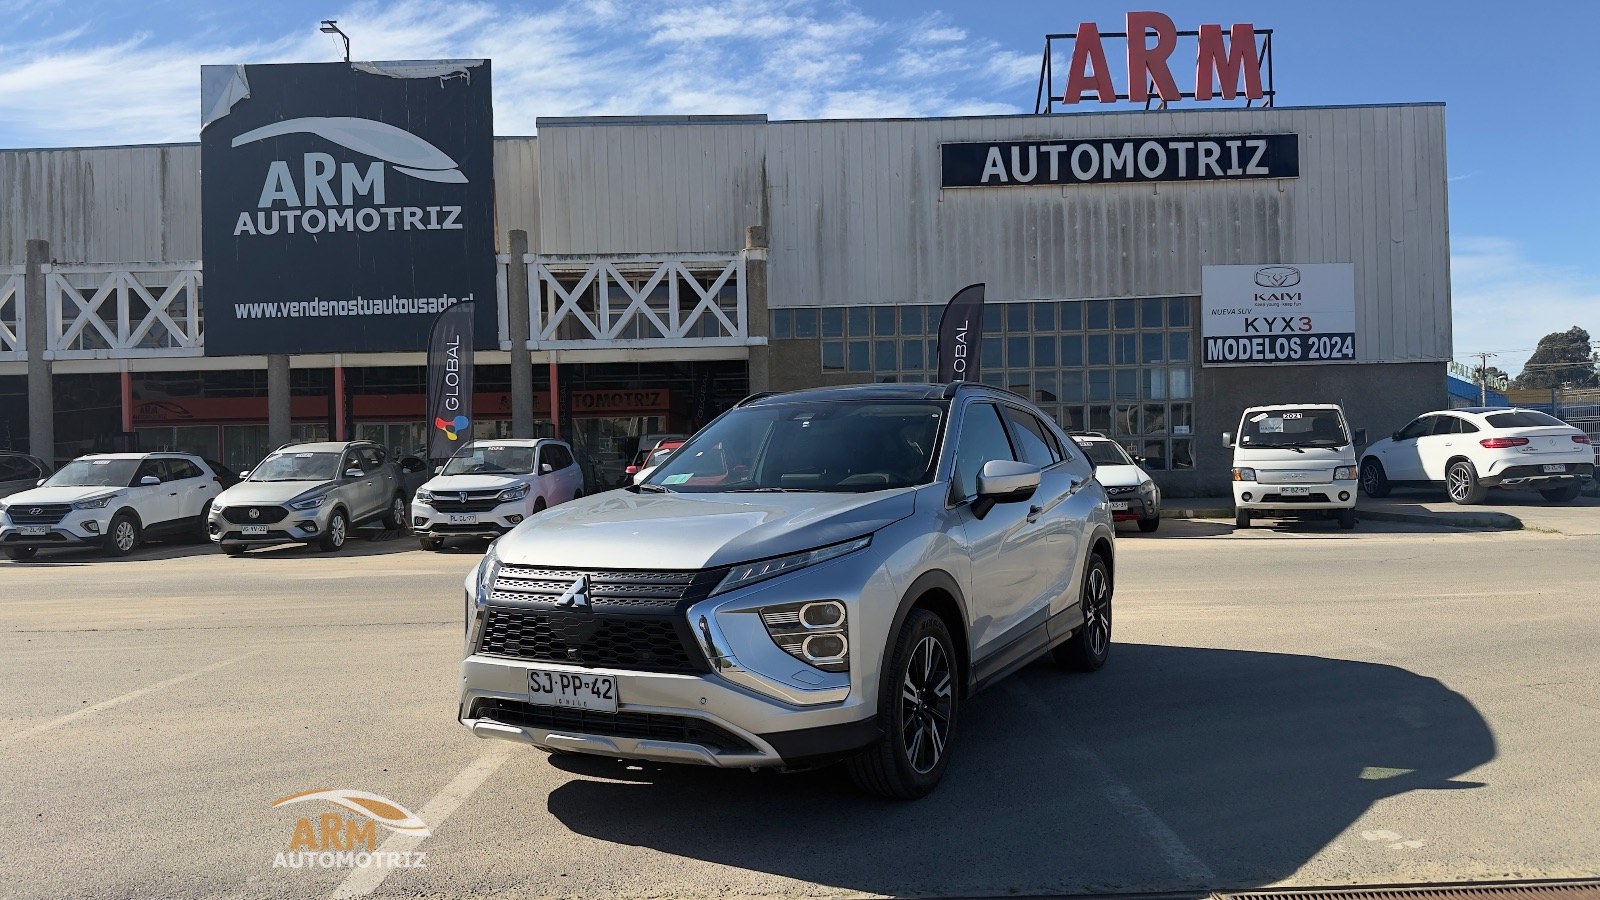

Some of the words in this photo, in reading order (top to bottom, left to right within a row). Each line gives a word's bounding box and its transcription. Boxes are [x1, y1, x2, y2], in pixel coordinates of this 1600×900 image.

[1063, 11, 1263, 104] ARM
[980, 139, 1270, 183] AUTOMOTRIZ
[258, 152, 386, 208] ARM
[233, 206, 463, 235] AUTOMOTRIZ
[1255, 292, 1301, 301] KAIYI
[1211, 308, 1236, 316] NUEVA
[1244, 316, 1312, 333] KYX3
[953, 320, 969, 382] LOBAL
[1207, 337, 1302, 361] MODELOS
[1308, 336, 1353, 359] 2024
[446, 335, 460, 411] GLOBAL
[572, 392, 661, 407] TOMOTRIZ
